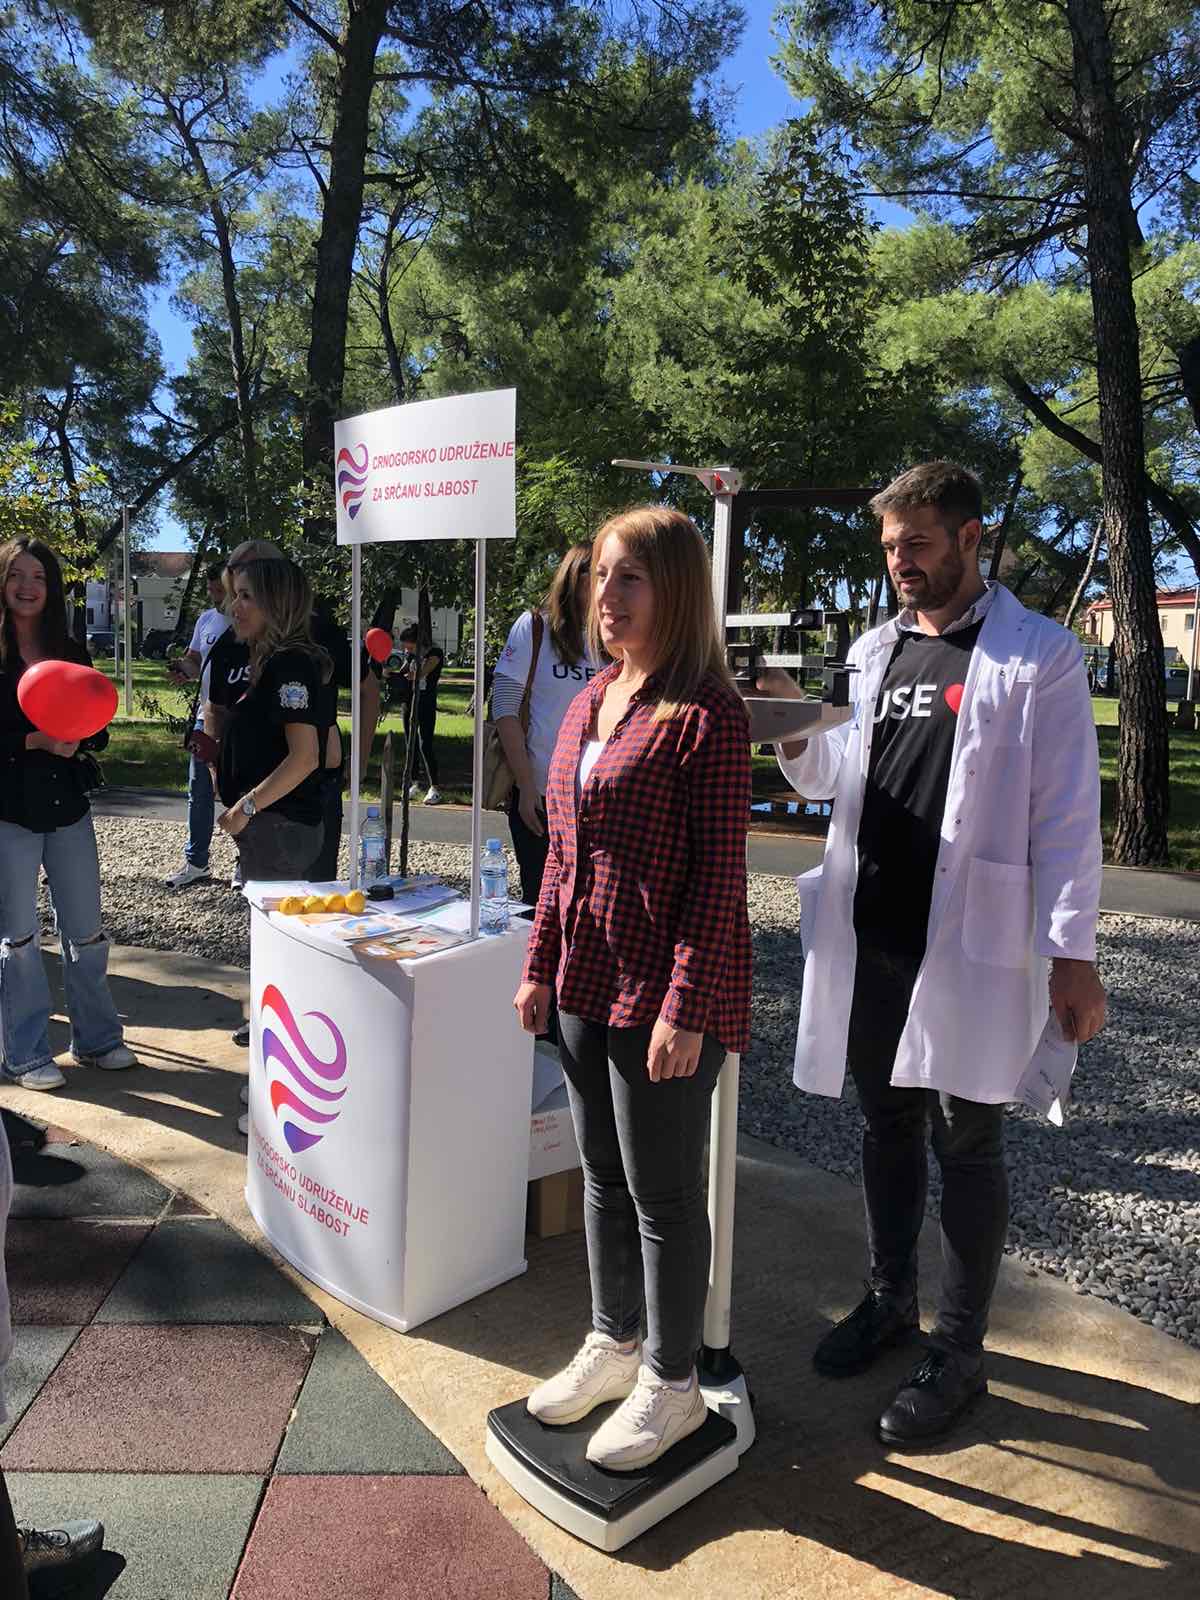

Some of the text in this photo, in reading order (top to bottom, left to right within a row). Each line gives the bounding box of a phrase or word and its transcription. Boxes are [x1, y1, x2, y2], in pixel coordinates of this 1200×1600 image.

[372, 440, 514, 470] CRNOGORSKO UDRUŽENJE
[372, 479, 479, 502] ZA SRČANU SLABOST
[297, 1193, 350, 1237] SLABOST
[299, 1171, 369, 1225] UDRUŽENJE
